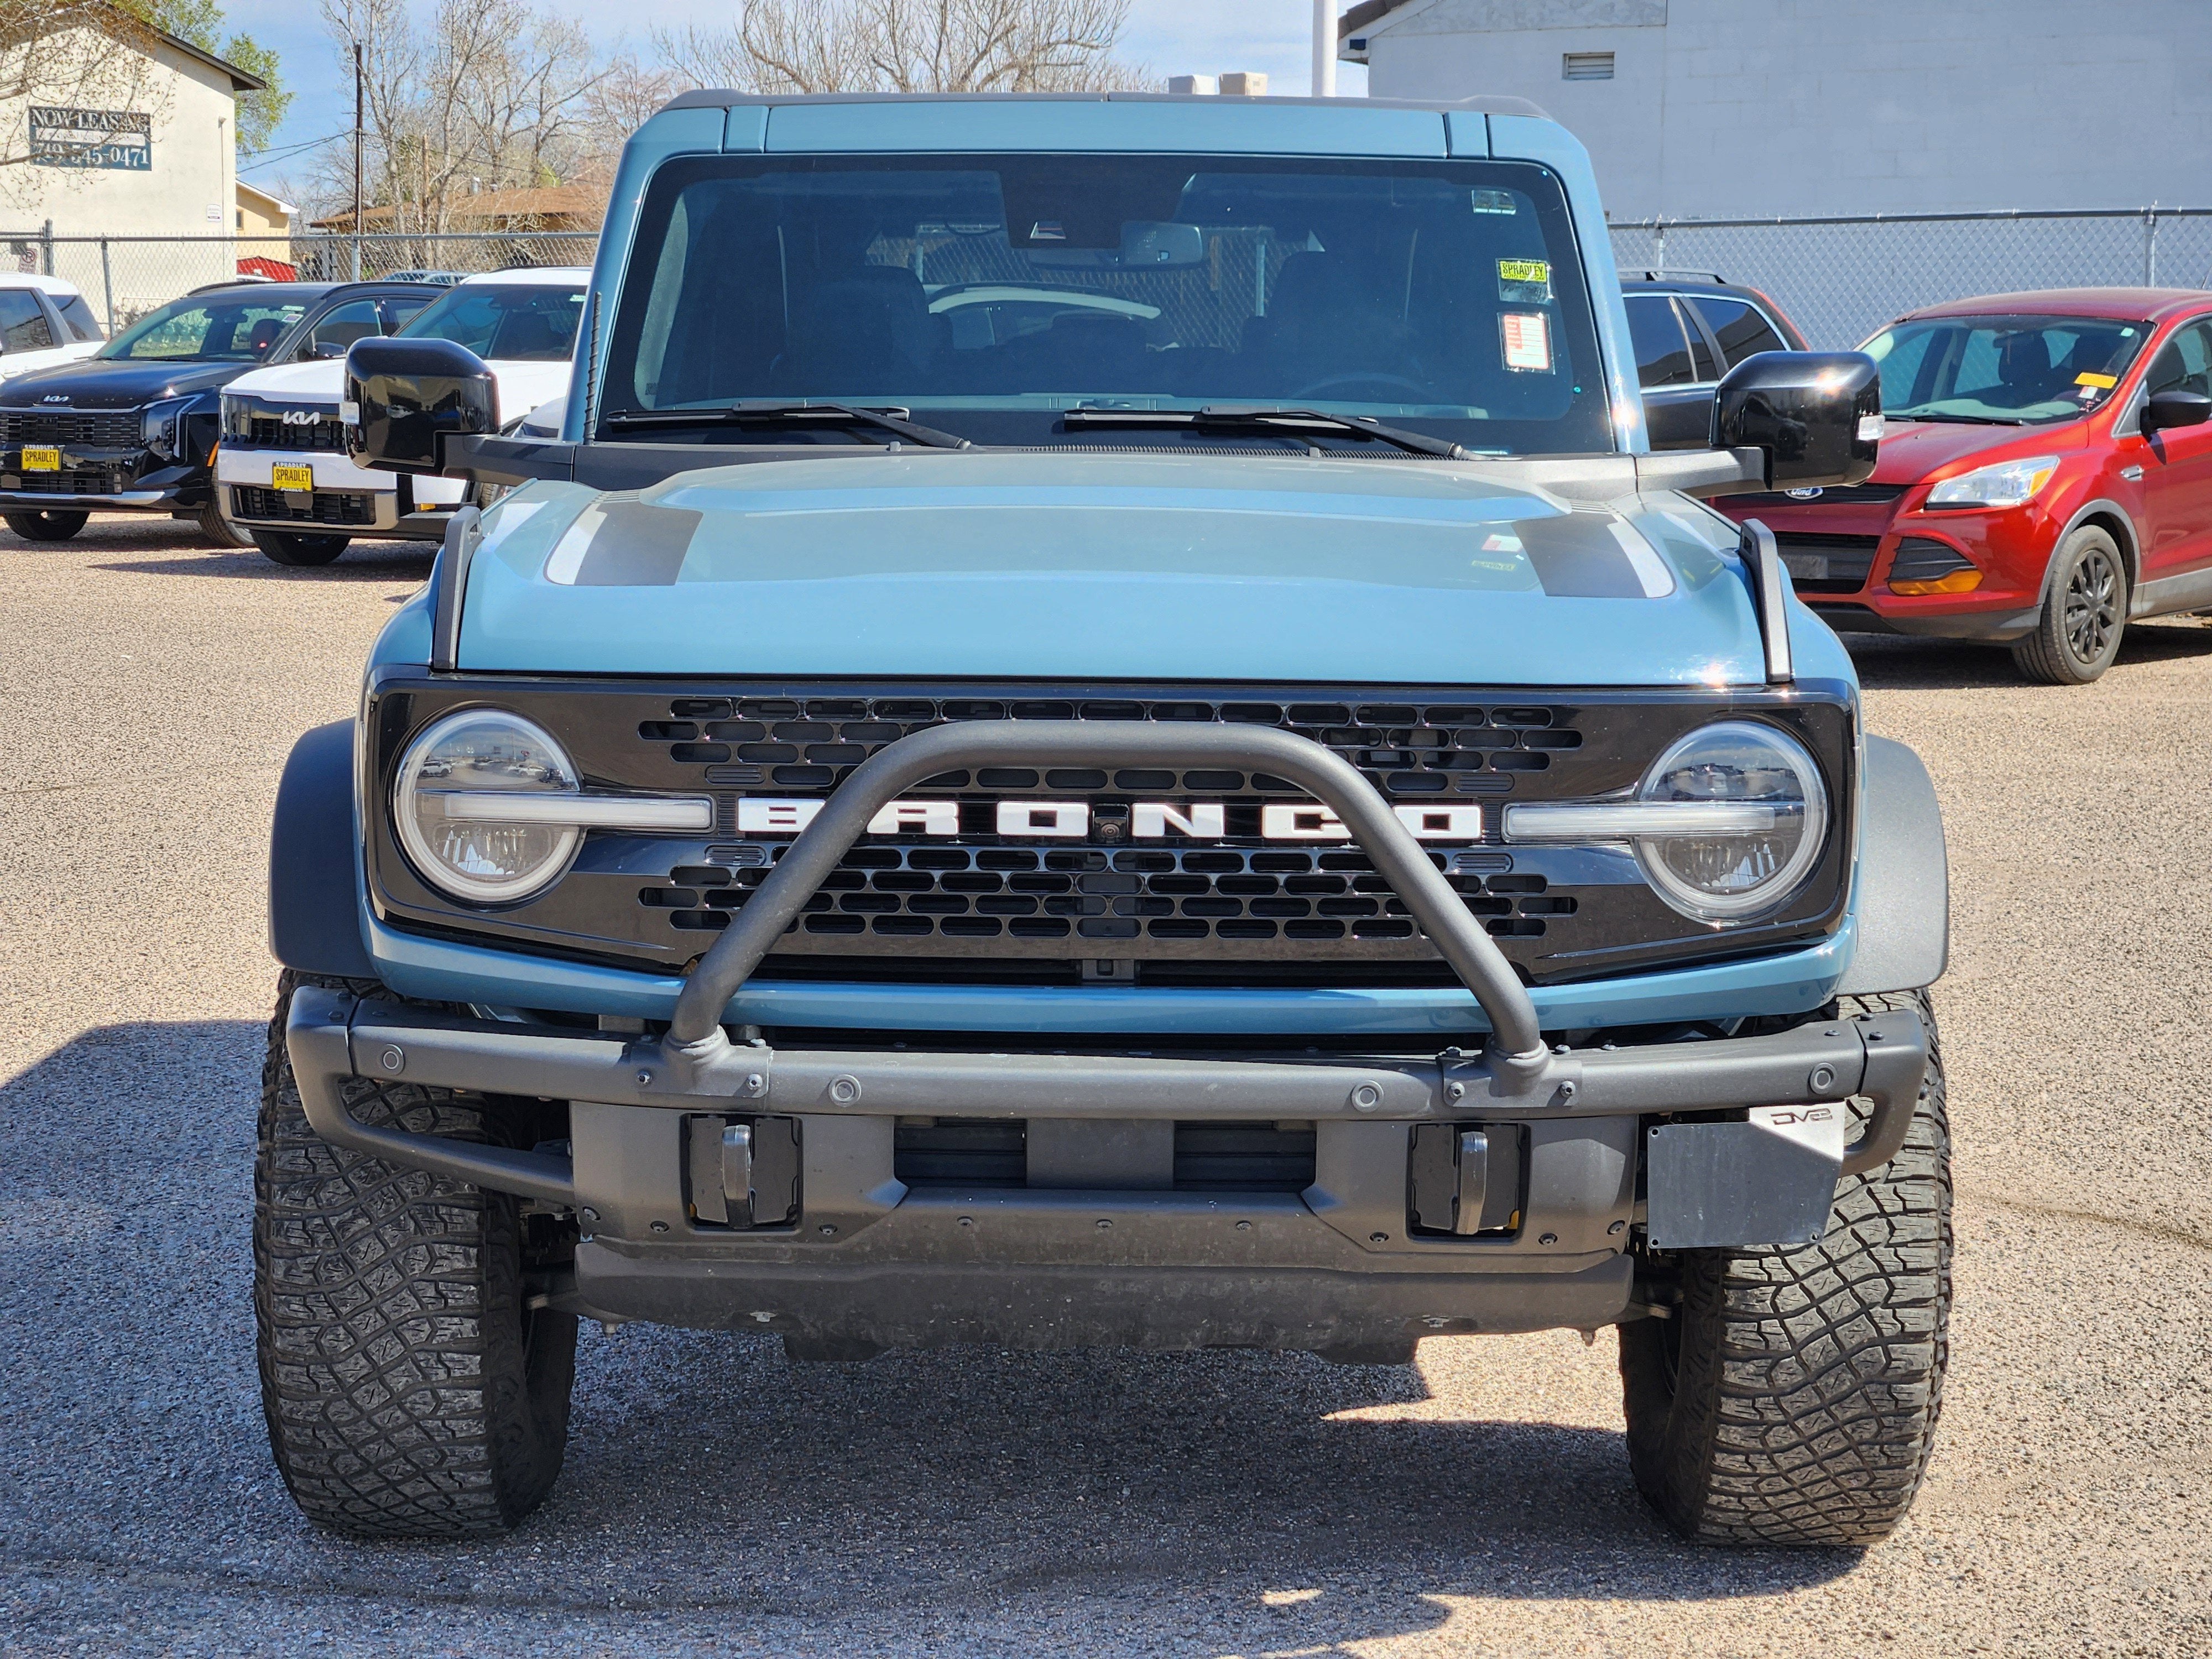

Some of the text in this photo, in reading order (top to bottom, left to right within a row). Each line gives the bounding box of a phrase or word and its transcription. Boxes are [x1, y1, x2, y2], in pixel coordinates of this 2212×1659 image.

[32, 109, 71, 127] NOW
[1503, 263, 1543, 277] SPRADLEY
[283, 411, 320, 426] KIA
[25, 450, 56, 462] SPRADLEY
[276, 468, 309, 482] SPRADLEY
[738, 797, 1483, 839] BRONCO
